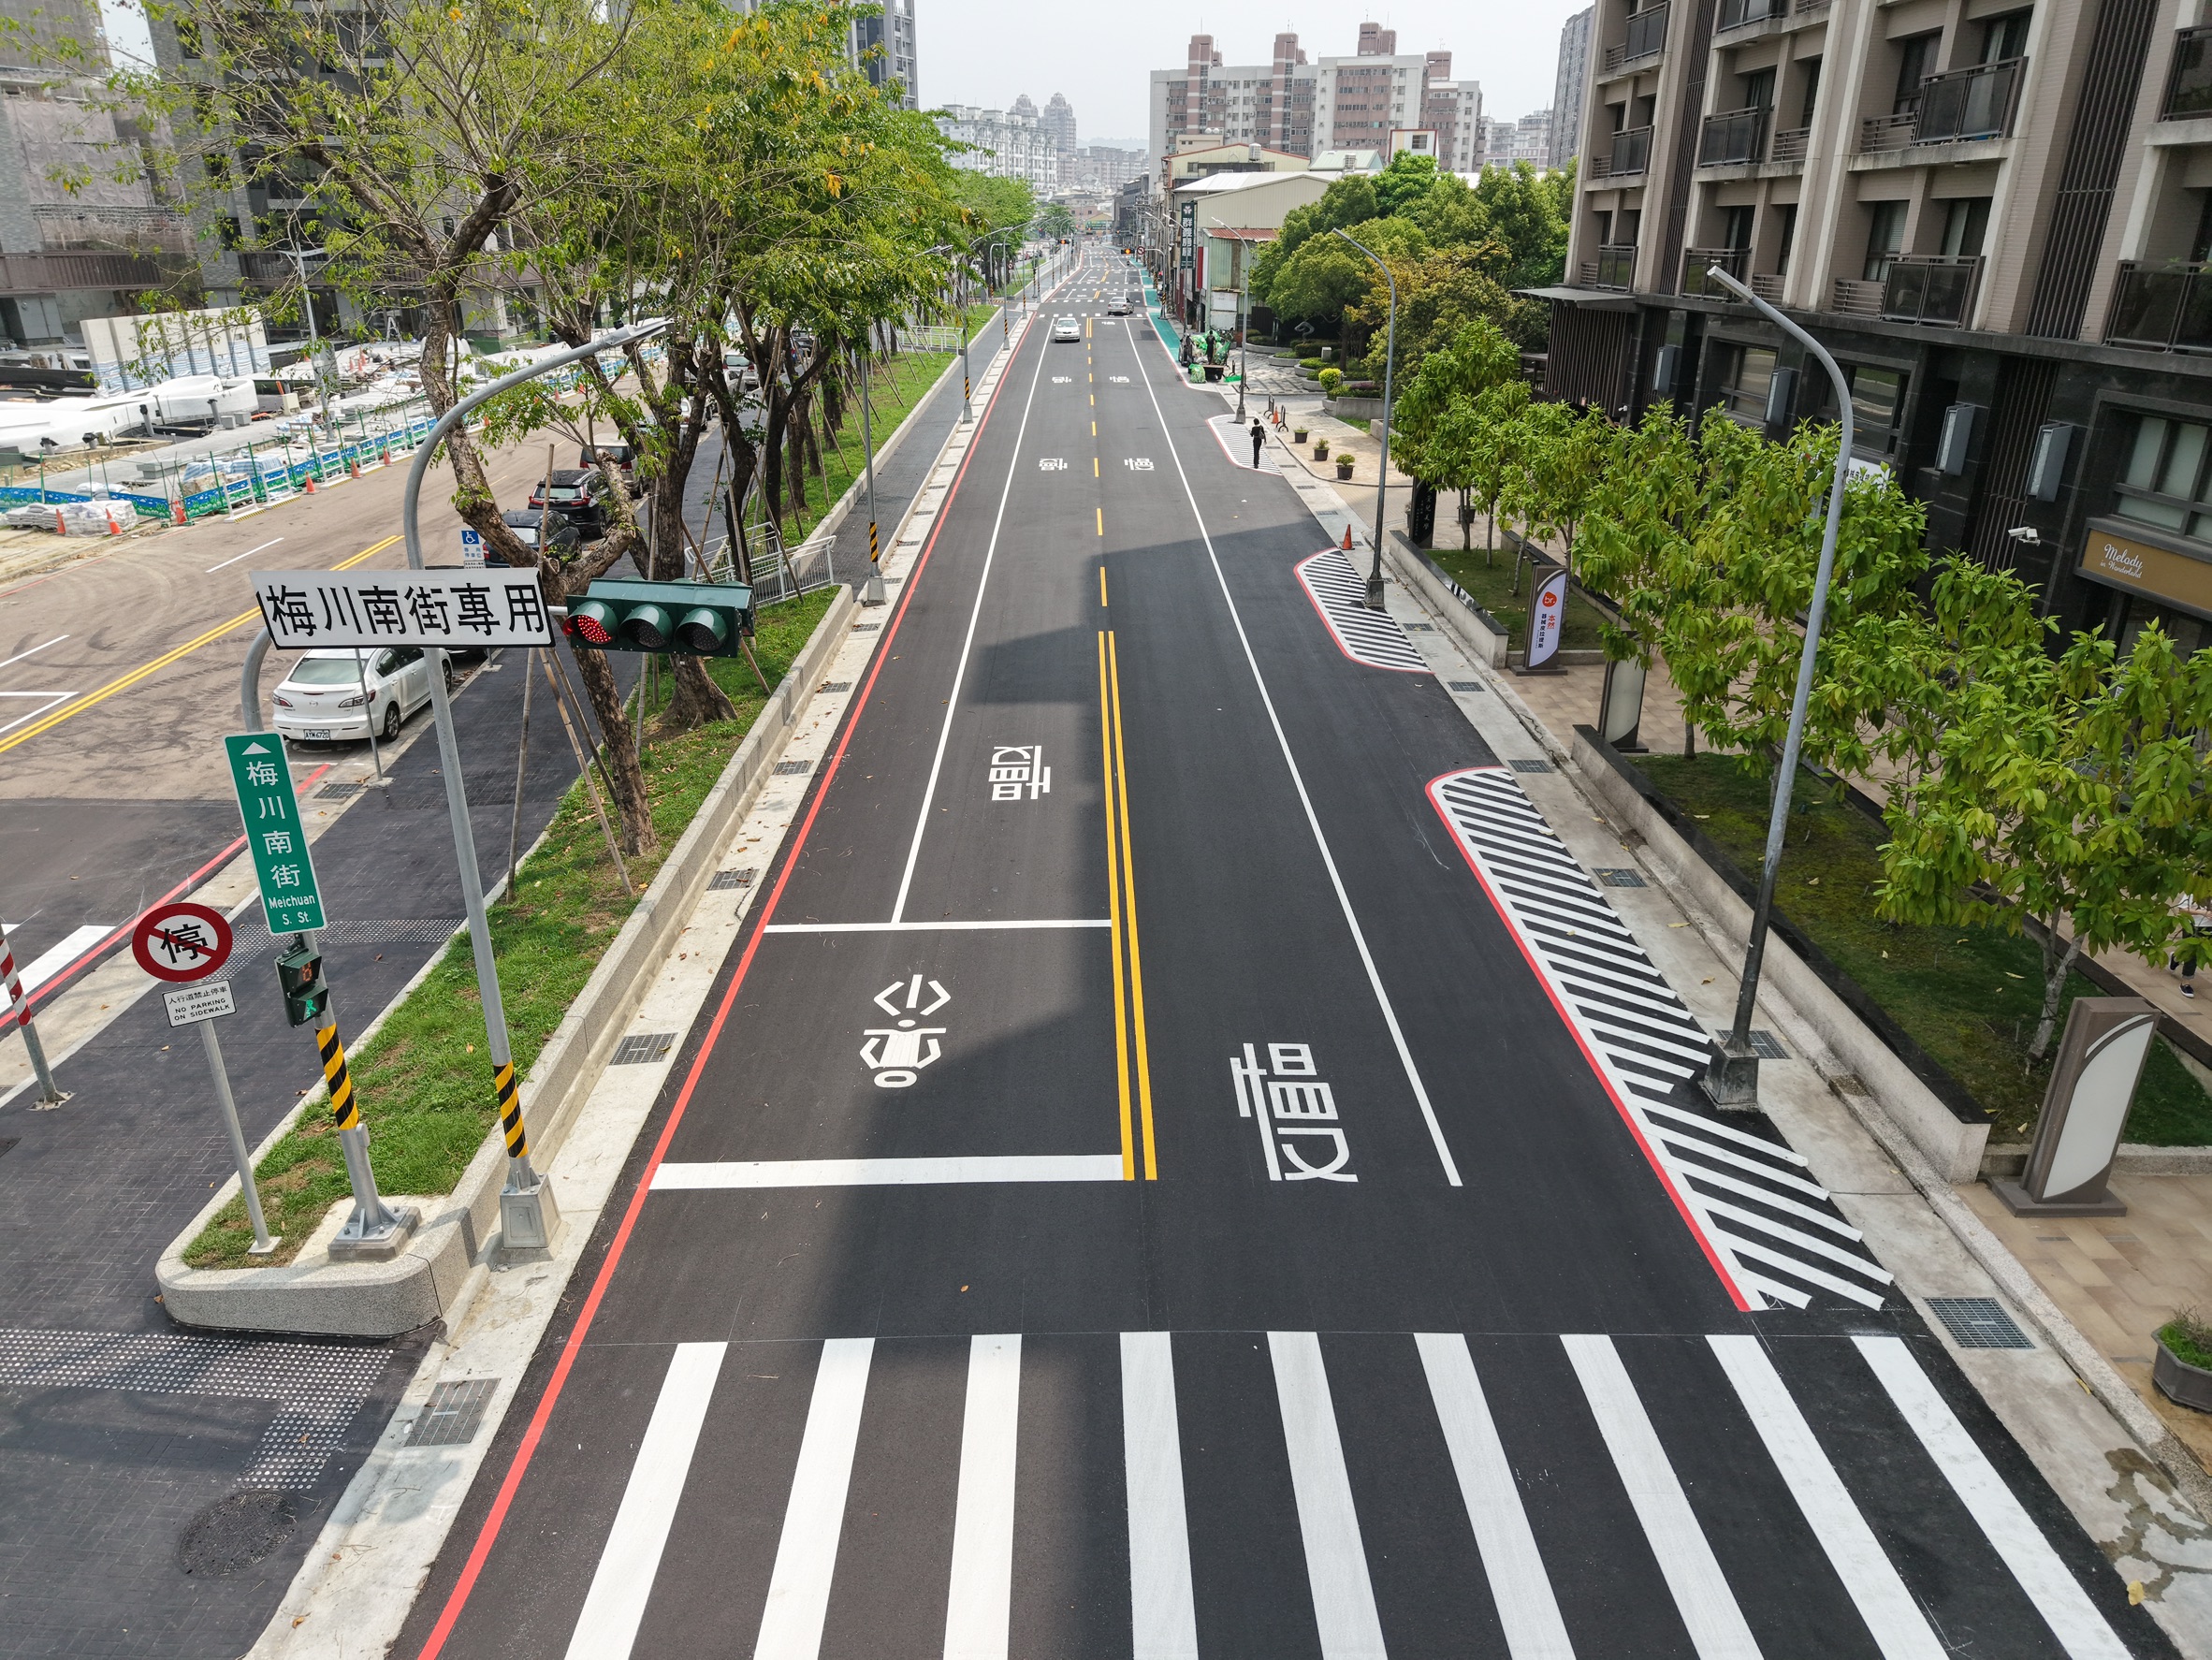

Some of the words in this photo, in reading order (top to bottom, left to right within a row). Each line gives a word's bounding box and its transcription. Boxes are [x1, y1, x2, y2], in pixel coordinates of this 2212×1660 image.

[1124, 458, 1155, 471] 慢
[2103, 543, 2143, 572] Melody
[2108, 561, 2143, 578] Wonderland
[266, 582, 545, 637] 梅川南街專用
[1547, 614, 1556, 630] 本然
[988, 745, 1051, 801] 慢
[245, 760, 300, 889] 梅川南街
[268, 894, 315, 910] Meichuan
[282, 913, 292, 925] S.
[297, 910, 312, 924] St.
[160, 924, 209, 964] 停
[168, 985, 227, 1005] 人行道禁止停車
[190, 997, 226, 1010] PARKING
[190, 1004, 230, 1017] SIDEWALK
[1230, 1042, 1359, 1184] 慢
